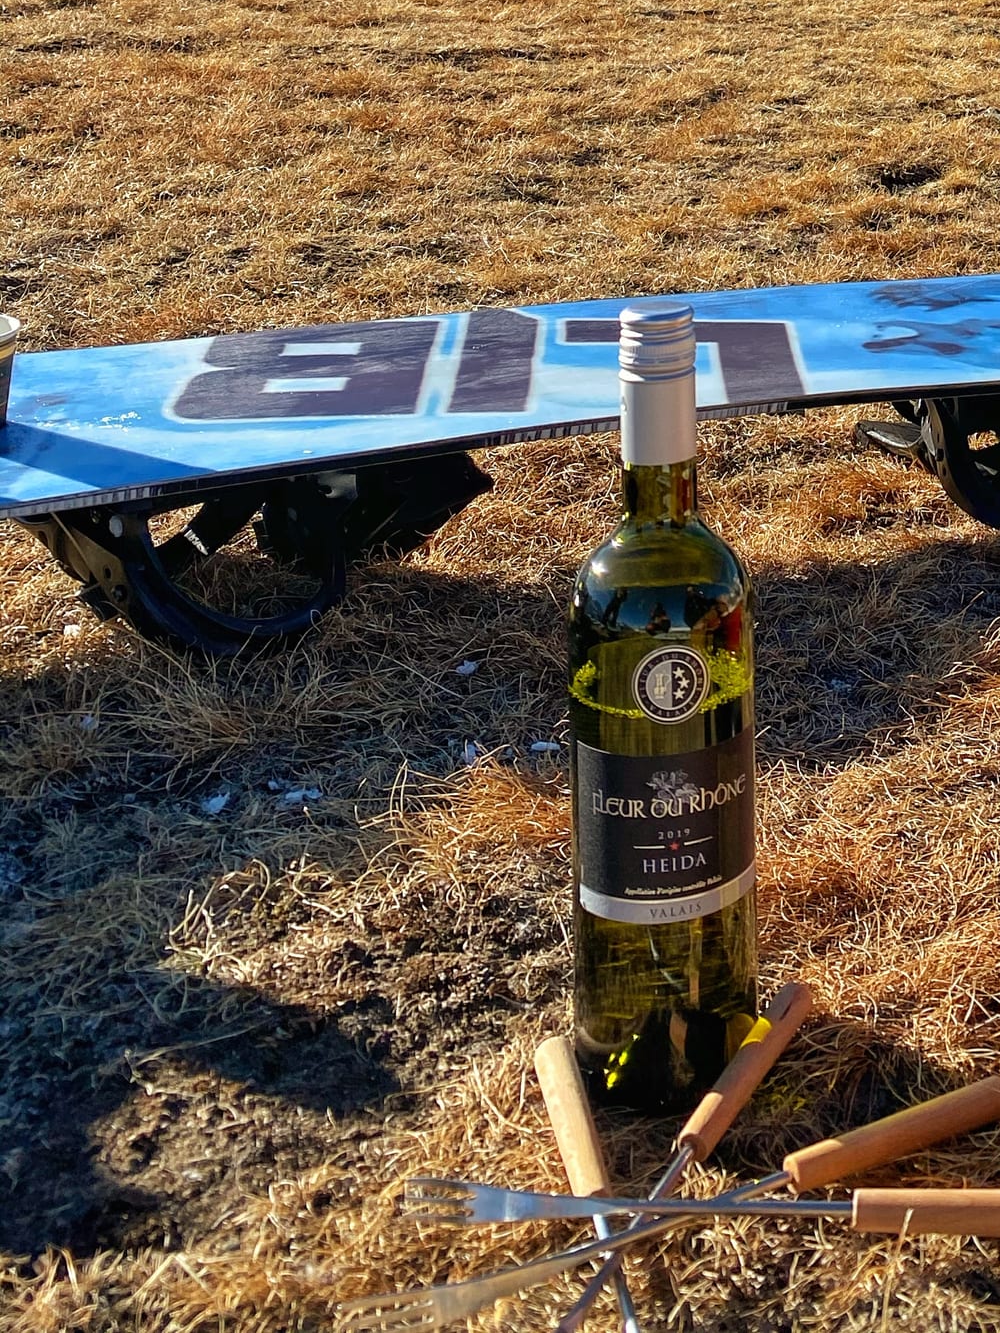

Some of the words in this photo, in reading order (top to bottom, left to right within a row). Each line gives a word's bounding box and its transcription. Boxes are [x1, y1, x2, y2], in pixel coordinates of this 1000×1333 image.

[592, 788, 647, 819] FLEUR
[650, 799, 683, 819] DU
[658, 828, 691, 840] 2019
[642, 853, 707, 873] HEIDA
[649, 901, 702, 918] VALAIS
